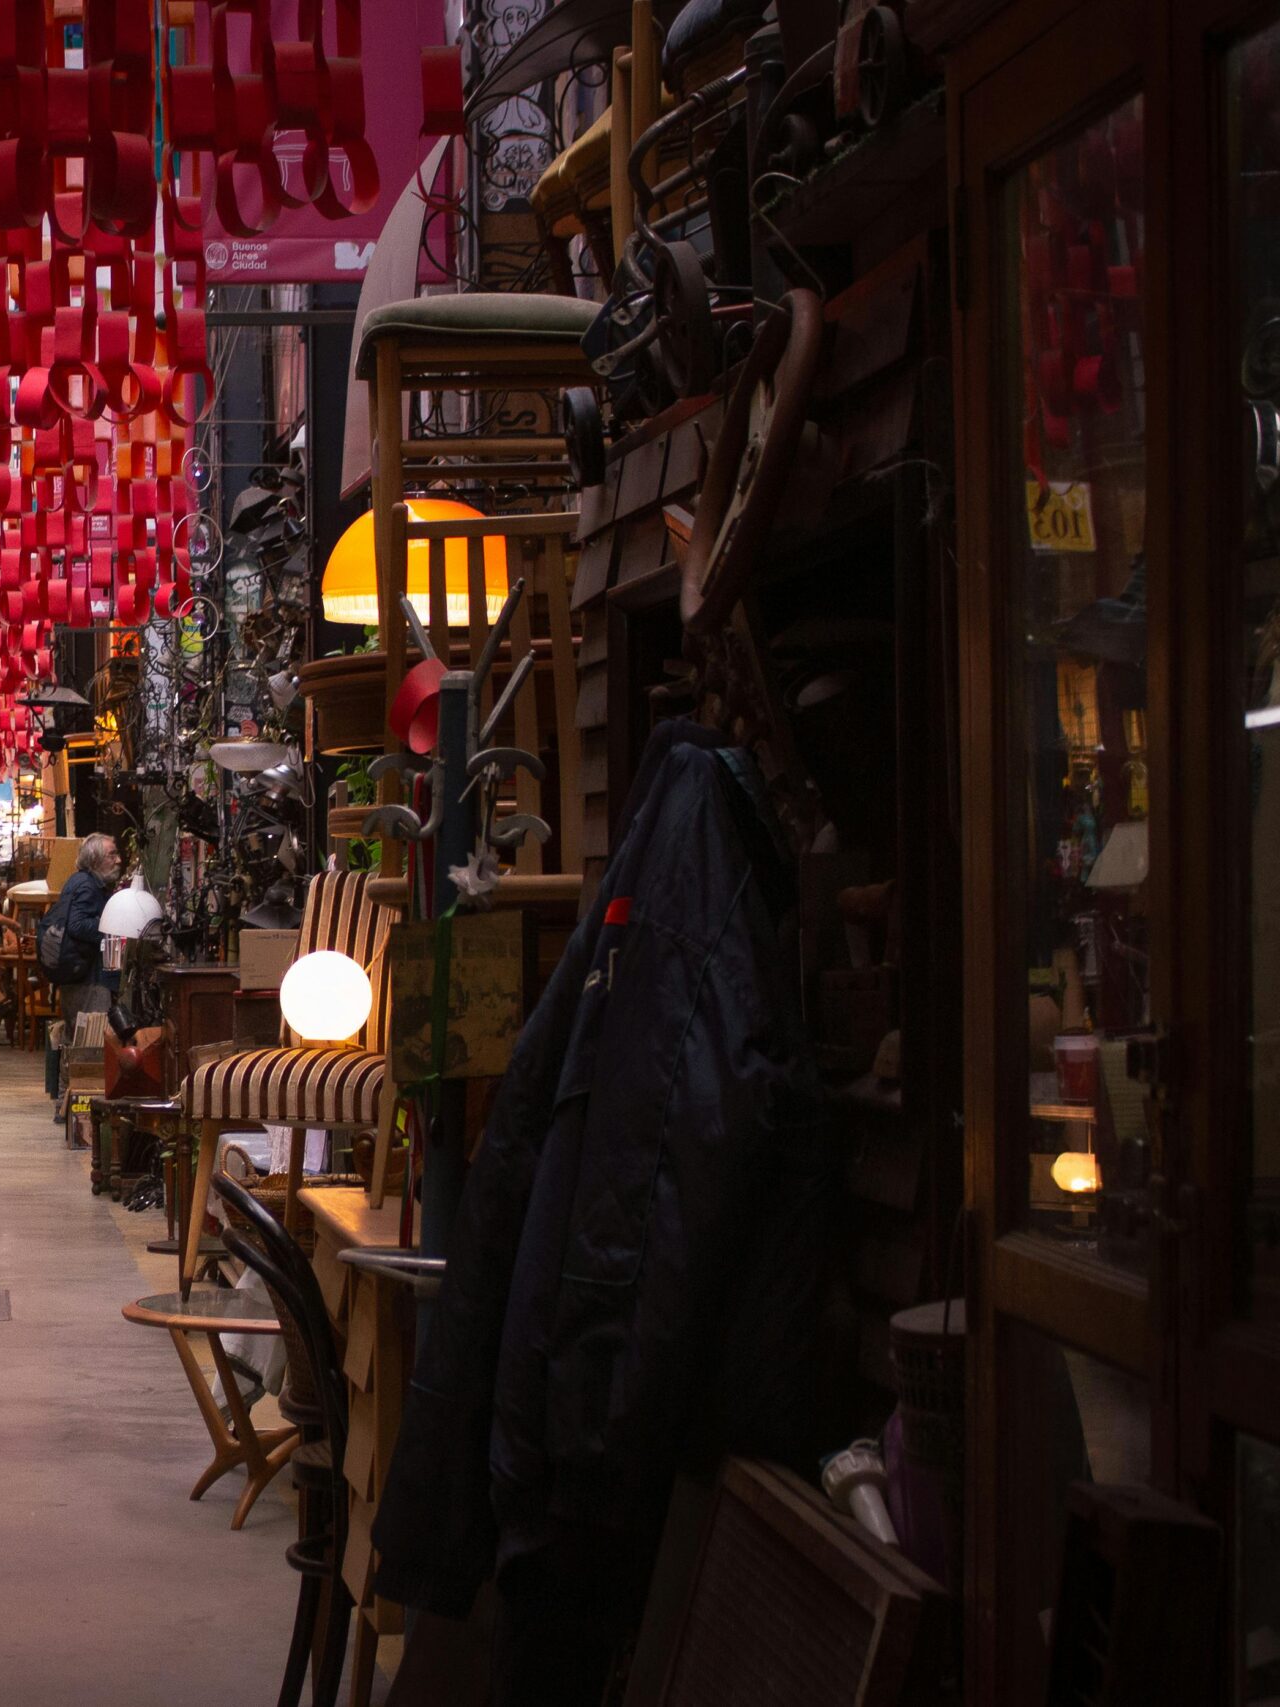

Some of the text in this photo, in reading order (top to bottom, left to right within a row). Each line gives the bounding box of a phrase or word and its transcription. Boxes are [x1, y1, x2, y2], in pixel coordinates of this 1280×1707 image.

[232, 241, 268, 250] Buenos
[232, 252, 258, 260] Aires
[232, 260, 267, 270] Ciudad
